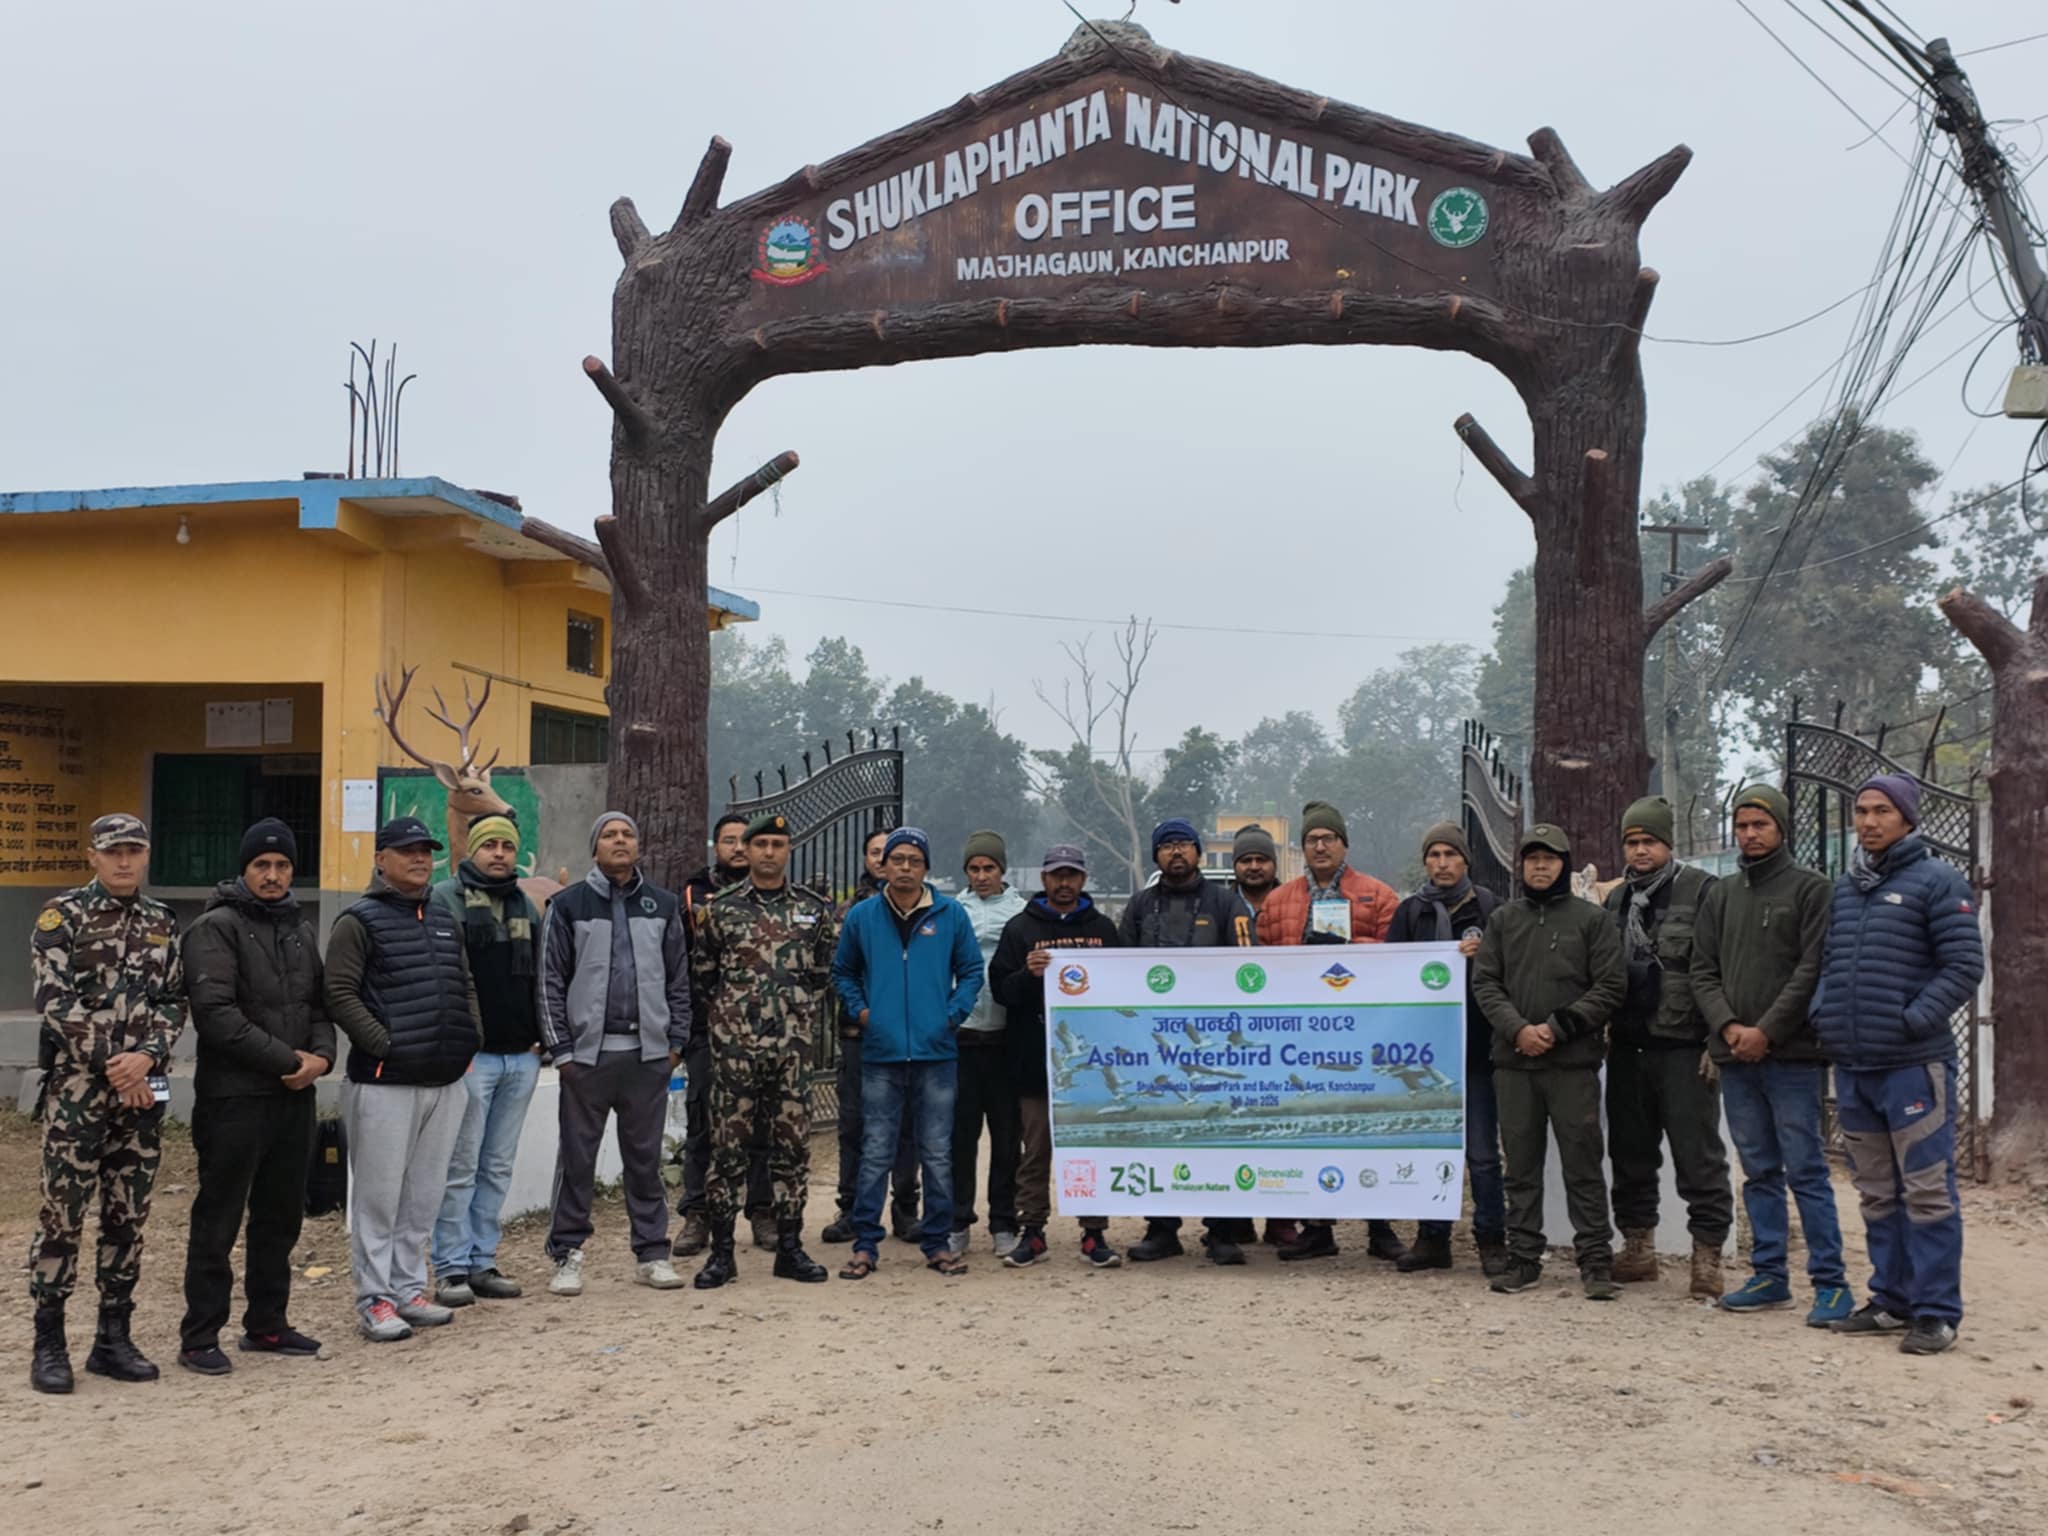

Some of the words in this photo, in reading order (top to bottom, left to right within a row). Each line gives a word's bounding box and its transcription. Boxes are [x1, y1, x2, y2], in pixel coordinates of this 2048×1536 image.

[826, 90, 1113, 250] SHUKLAPHANTA
[1124, 92, 1319, 200] NATIONAL
[1323, 152, 1420, 226] PARK
[1013, 184, 1196, 241] OFFICE
[957, 249, 1121, 281] MAJHAGAUN,
[1123, 238, 1290, 270] KANCHANPUR
[1153, 1016, 1187, 1033] जल
[1194, 1012, 1242, 1033] पन्छी
[1248, 1015, 1302, 1033] गणना
[1308, 1016, 1355, 1032] २०८२
[1087, 1047, 1149, 1067] Asian
[1158, 1045, 1271, 1067] Waterbird
[1280, 1045, 1363, 1066] Census
[1371, 1043, 1434, 1066] 2026
[1223, 1081, 1241, 1092] Park
[1243, 1081, 1257, 1091] and
[1259, 1080, 1283, 1092] Buffer
[1110, 1161, 1164, 1196] ZSL
[1258, 1167, 1303, 1178] Renewable
[1064, 1188, 1096, 1198] NTNC
